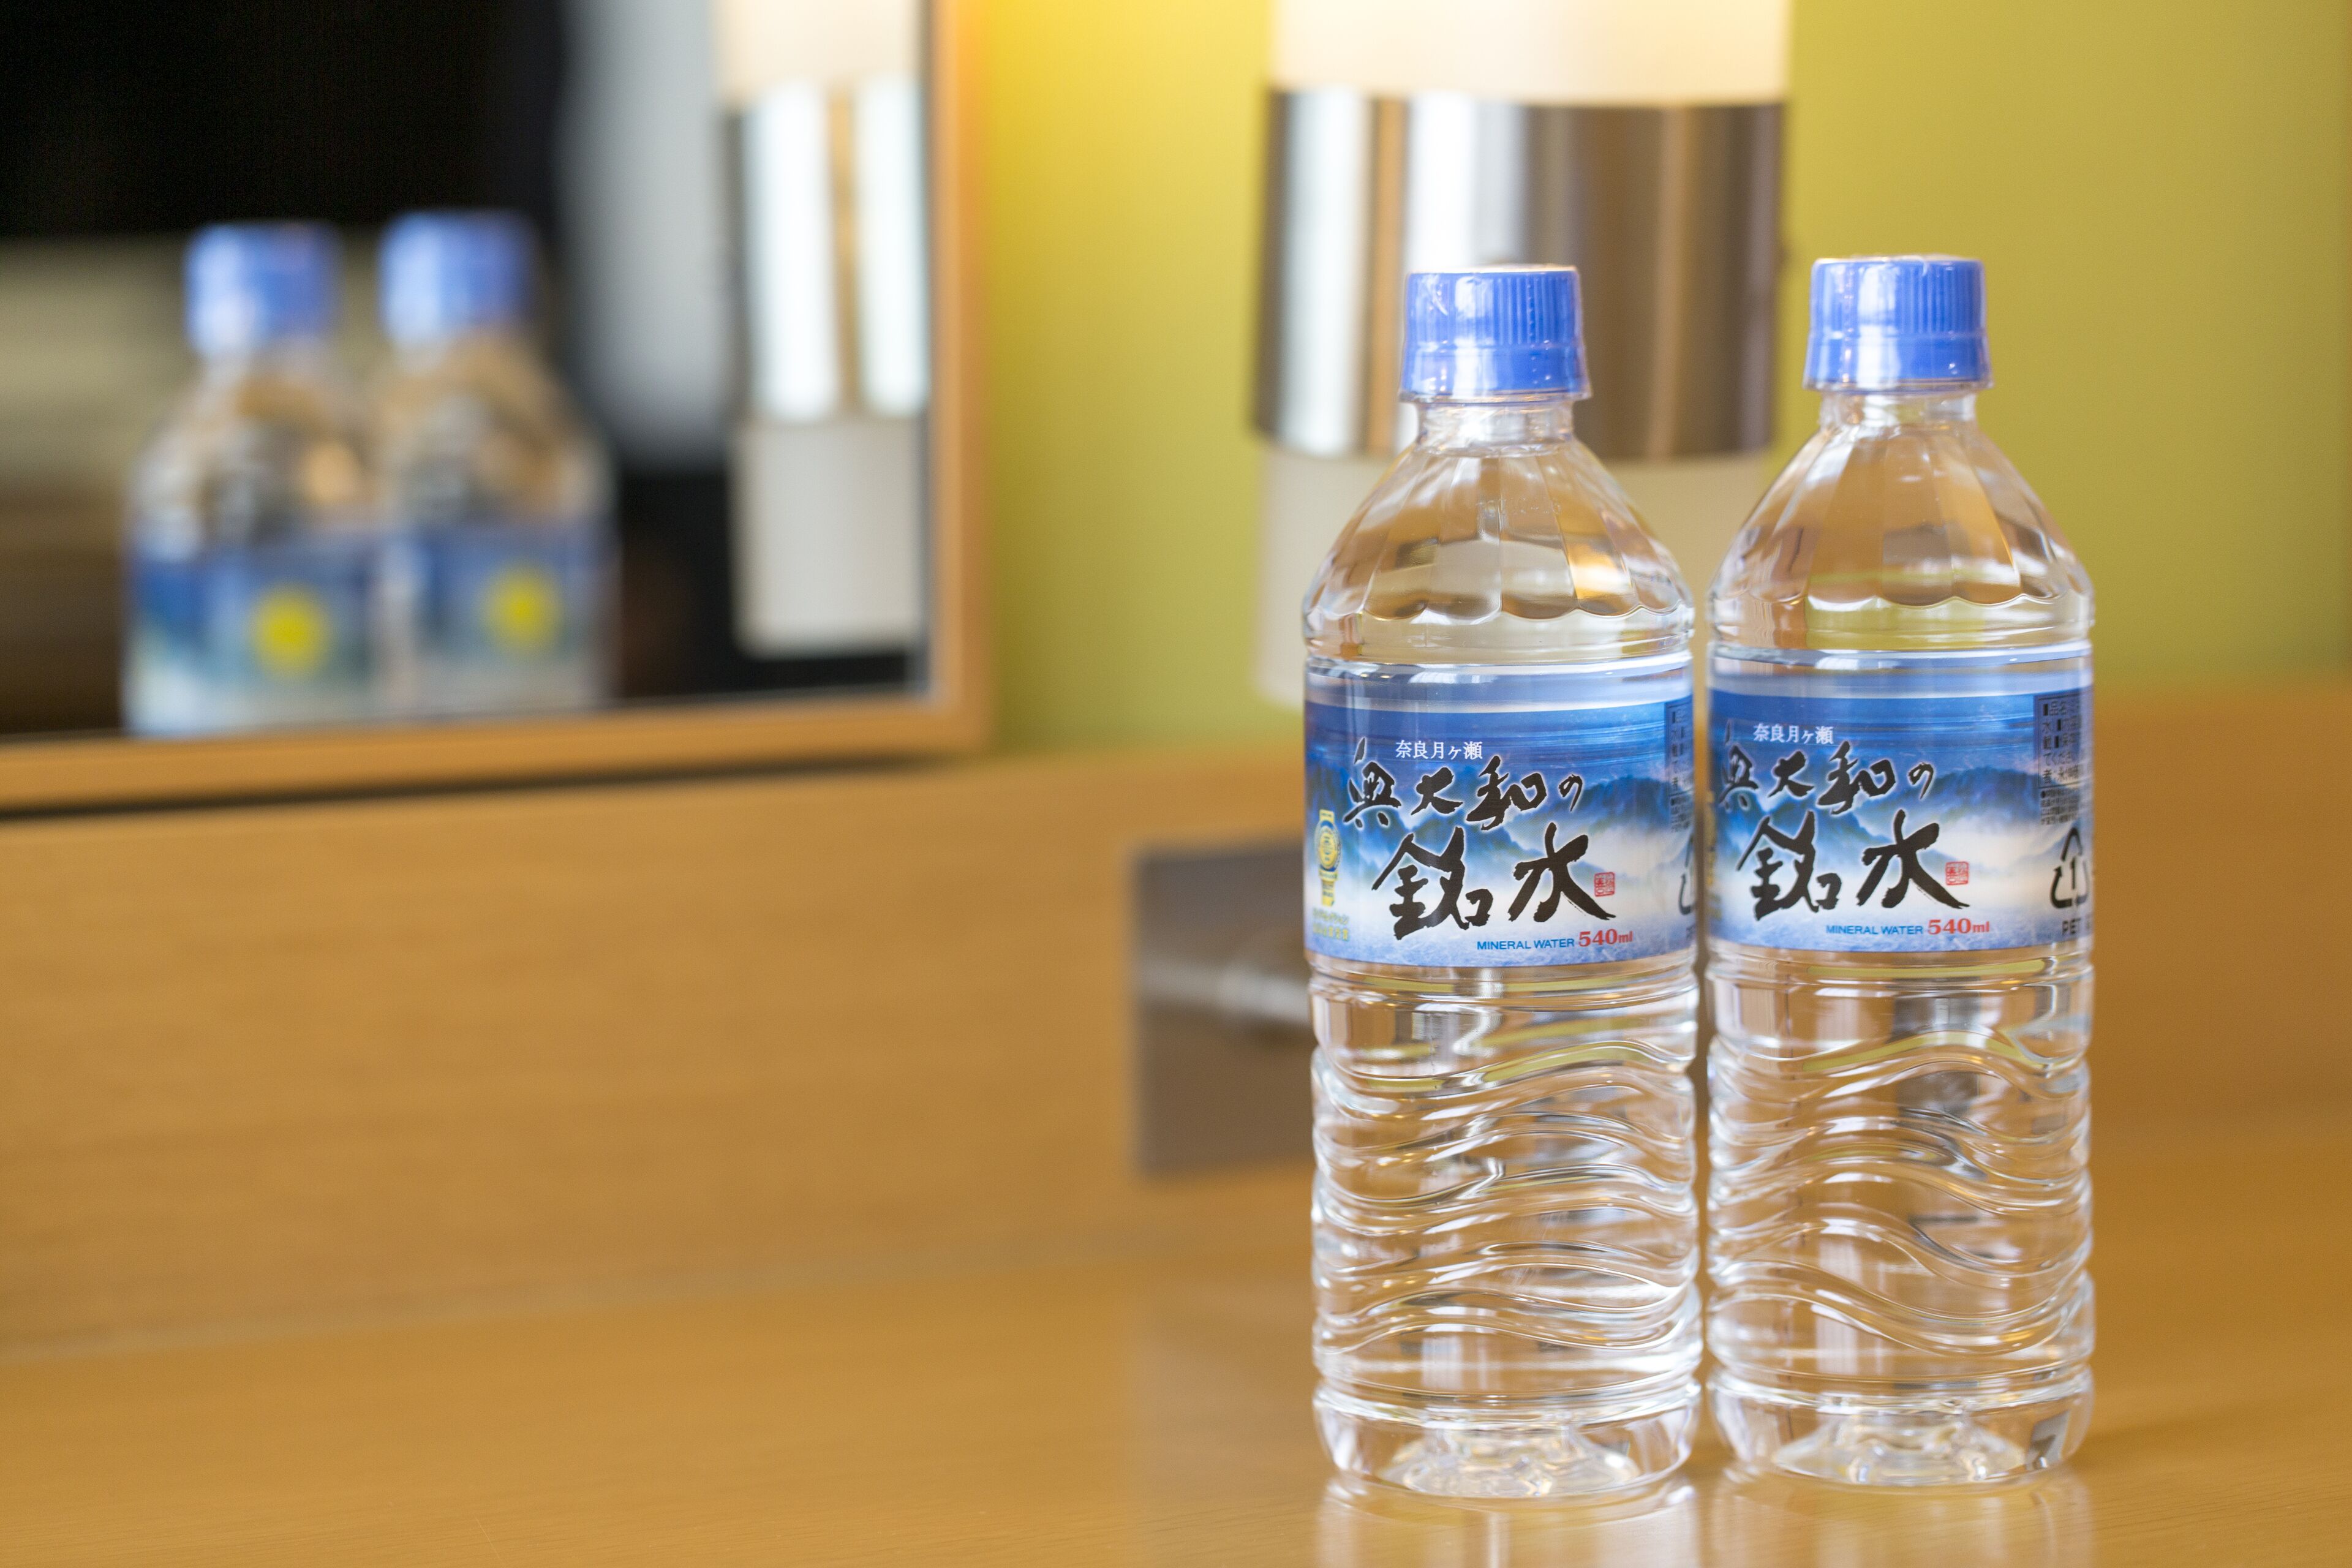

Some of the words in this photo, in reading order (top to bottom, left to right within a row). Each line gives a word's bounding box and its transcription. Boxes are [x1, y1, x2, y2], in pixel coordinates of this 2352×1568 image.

[1395, 739, 1483, 760] 奈良月ヶ瀬
[1737, 809, 1970, 921] 銘水
[1371, 822, 1616, 940] 銘水
[1826, 925, 1878, 935] MINERAL
[1880, 925, 1923, 935] WATER
[1928, 918, 1990, 935] 540ml
[1477, 940, 1531, 950] MINERAL
[1533, 938, 1575, 949] WATER
[1578, 929, 1634, 947] 540ml
